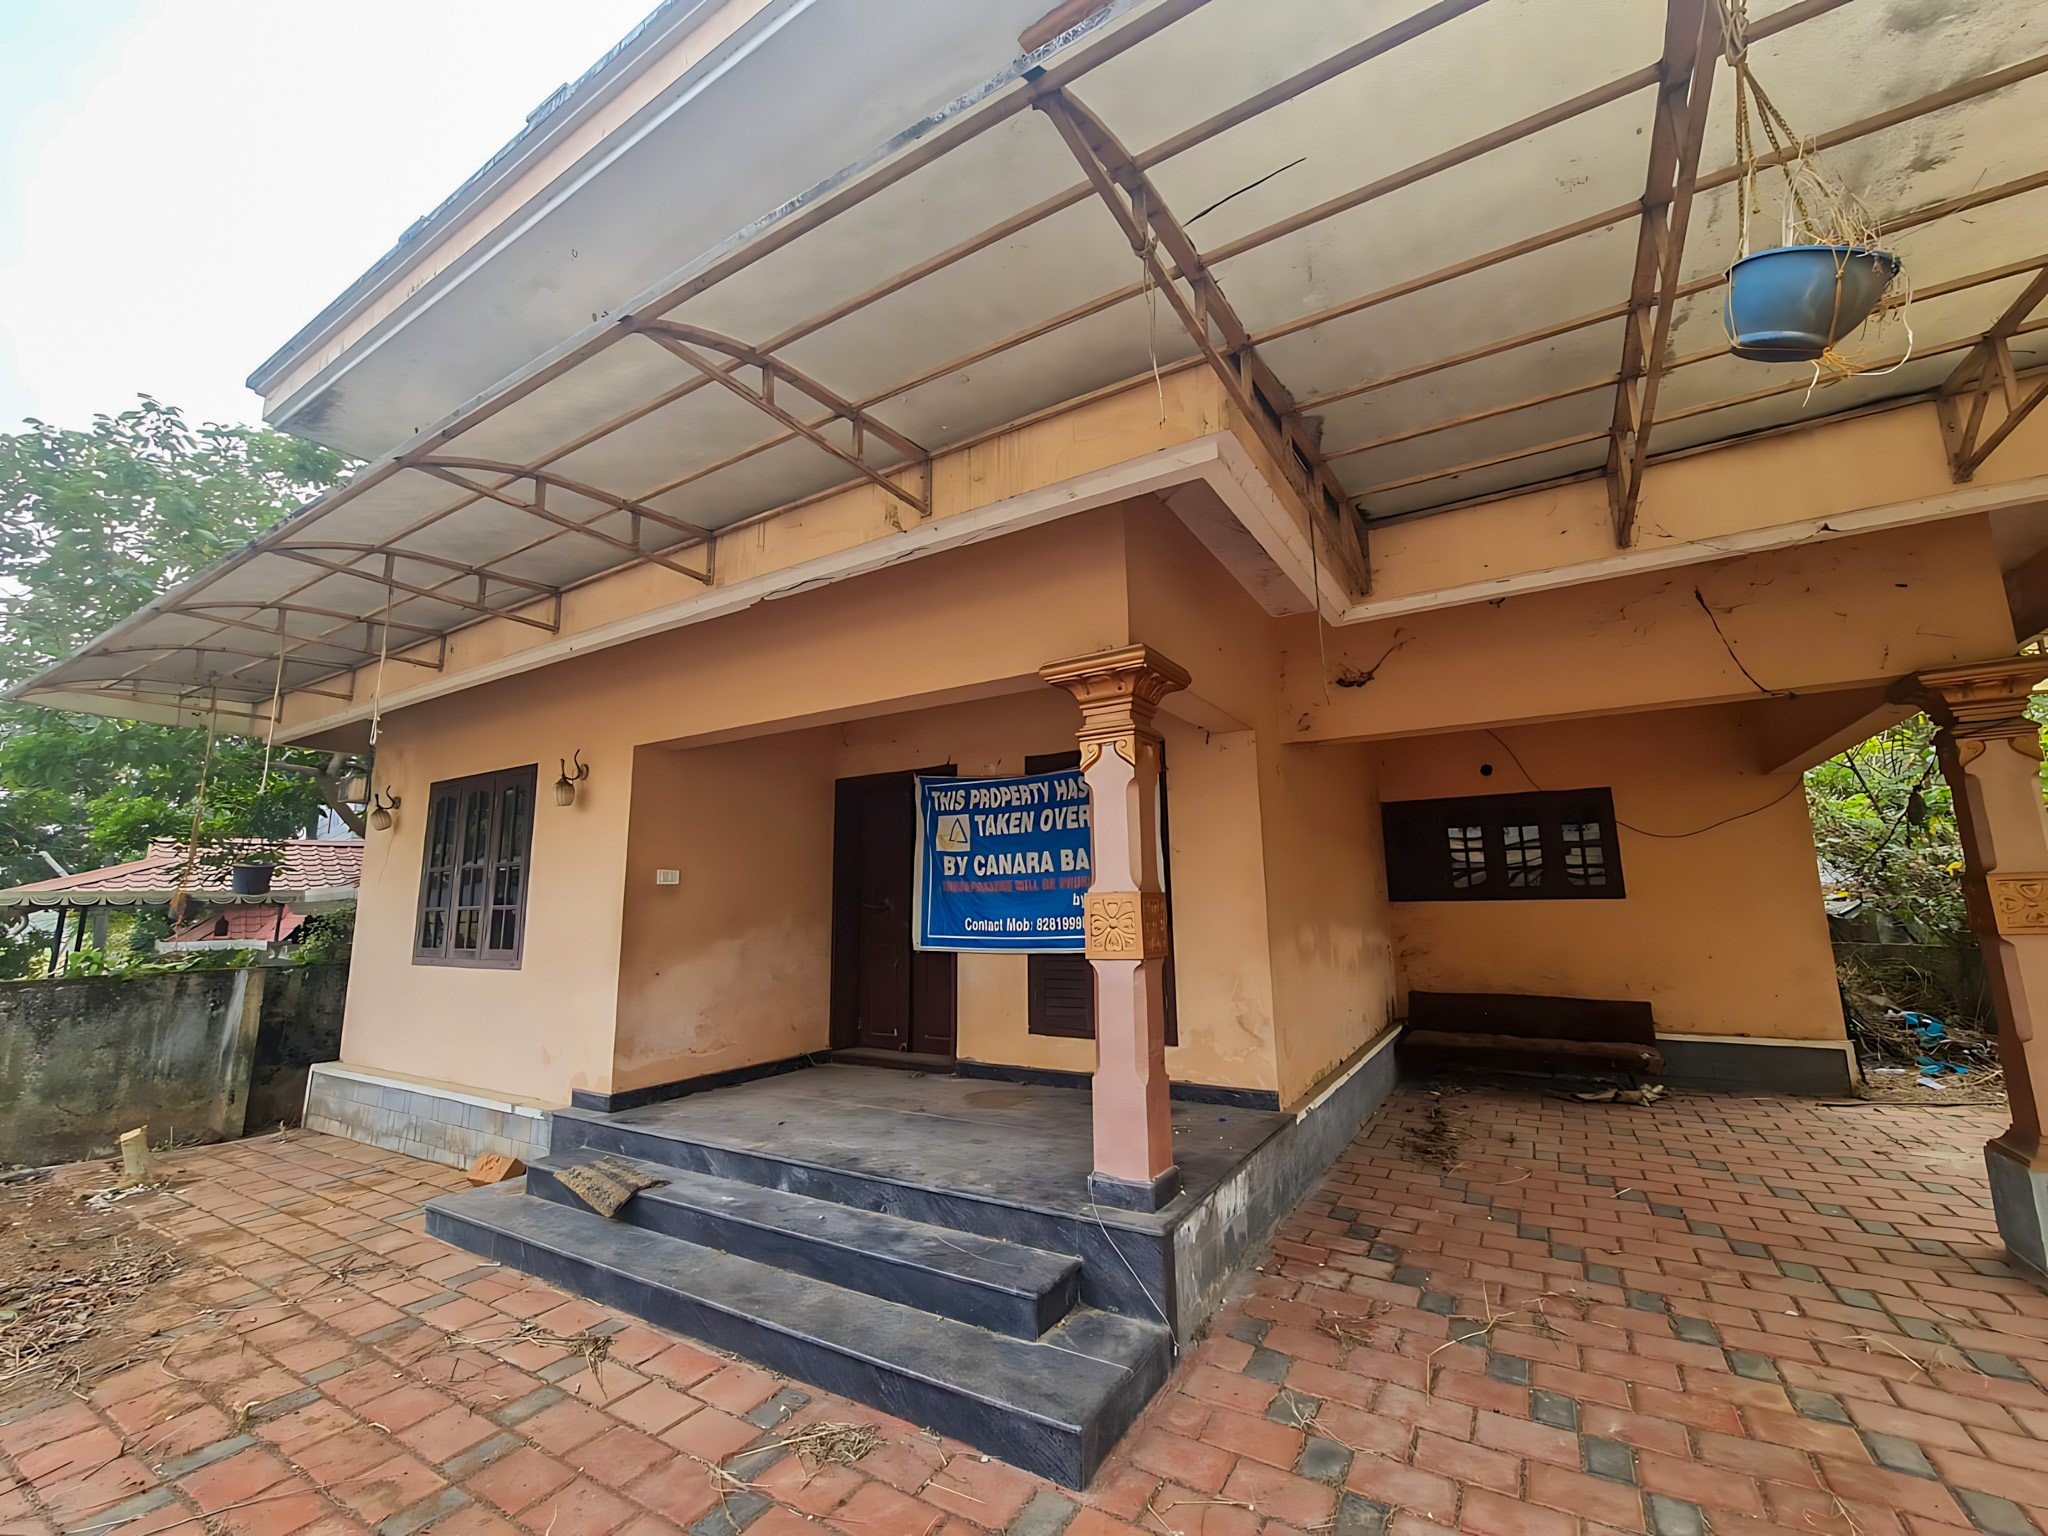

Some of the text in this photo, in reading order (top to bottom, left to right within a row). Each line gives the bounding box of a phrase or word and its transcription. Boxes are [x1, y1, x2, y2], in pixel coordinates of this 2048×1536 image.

[932, 776, 1089, 811] THIS PROPERTY HAS
[974, 804, 1091, 836] TAKEN OVER
[943, 855, 968, 876] BY
[973, 851, 1054, 876] CANARA
[965, 917, 1003, 931] Contact
[1006, 917, 1033, 931] Mob:
